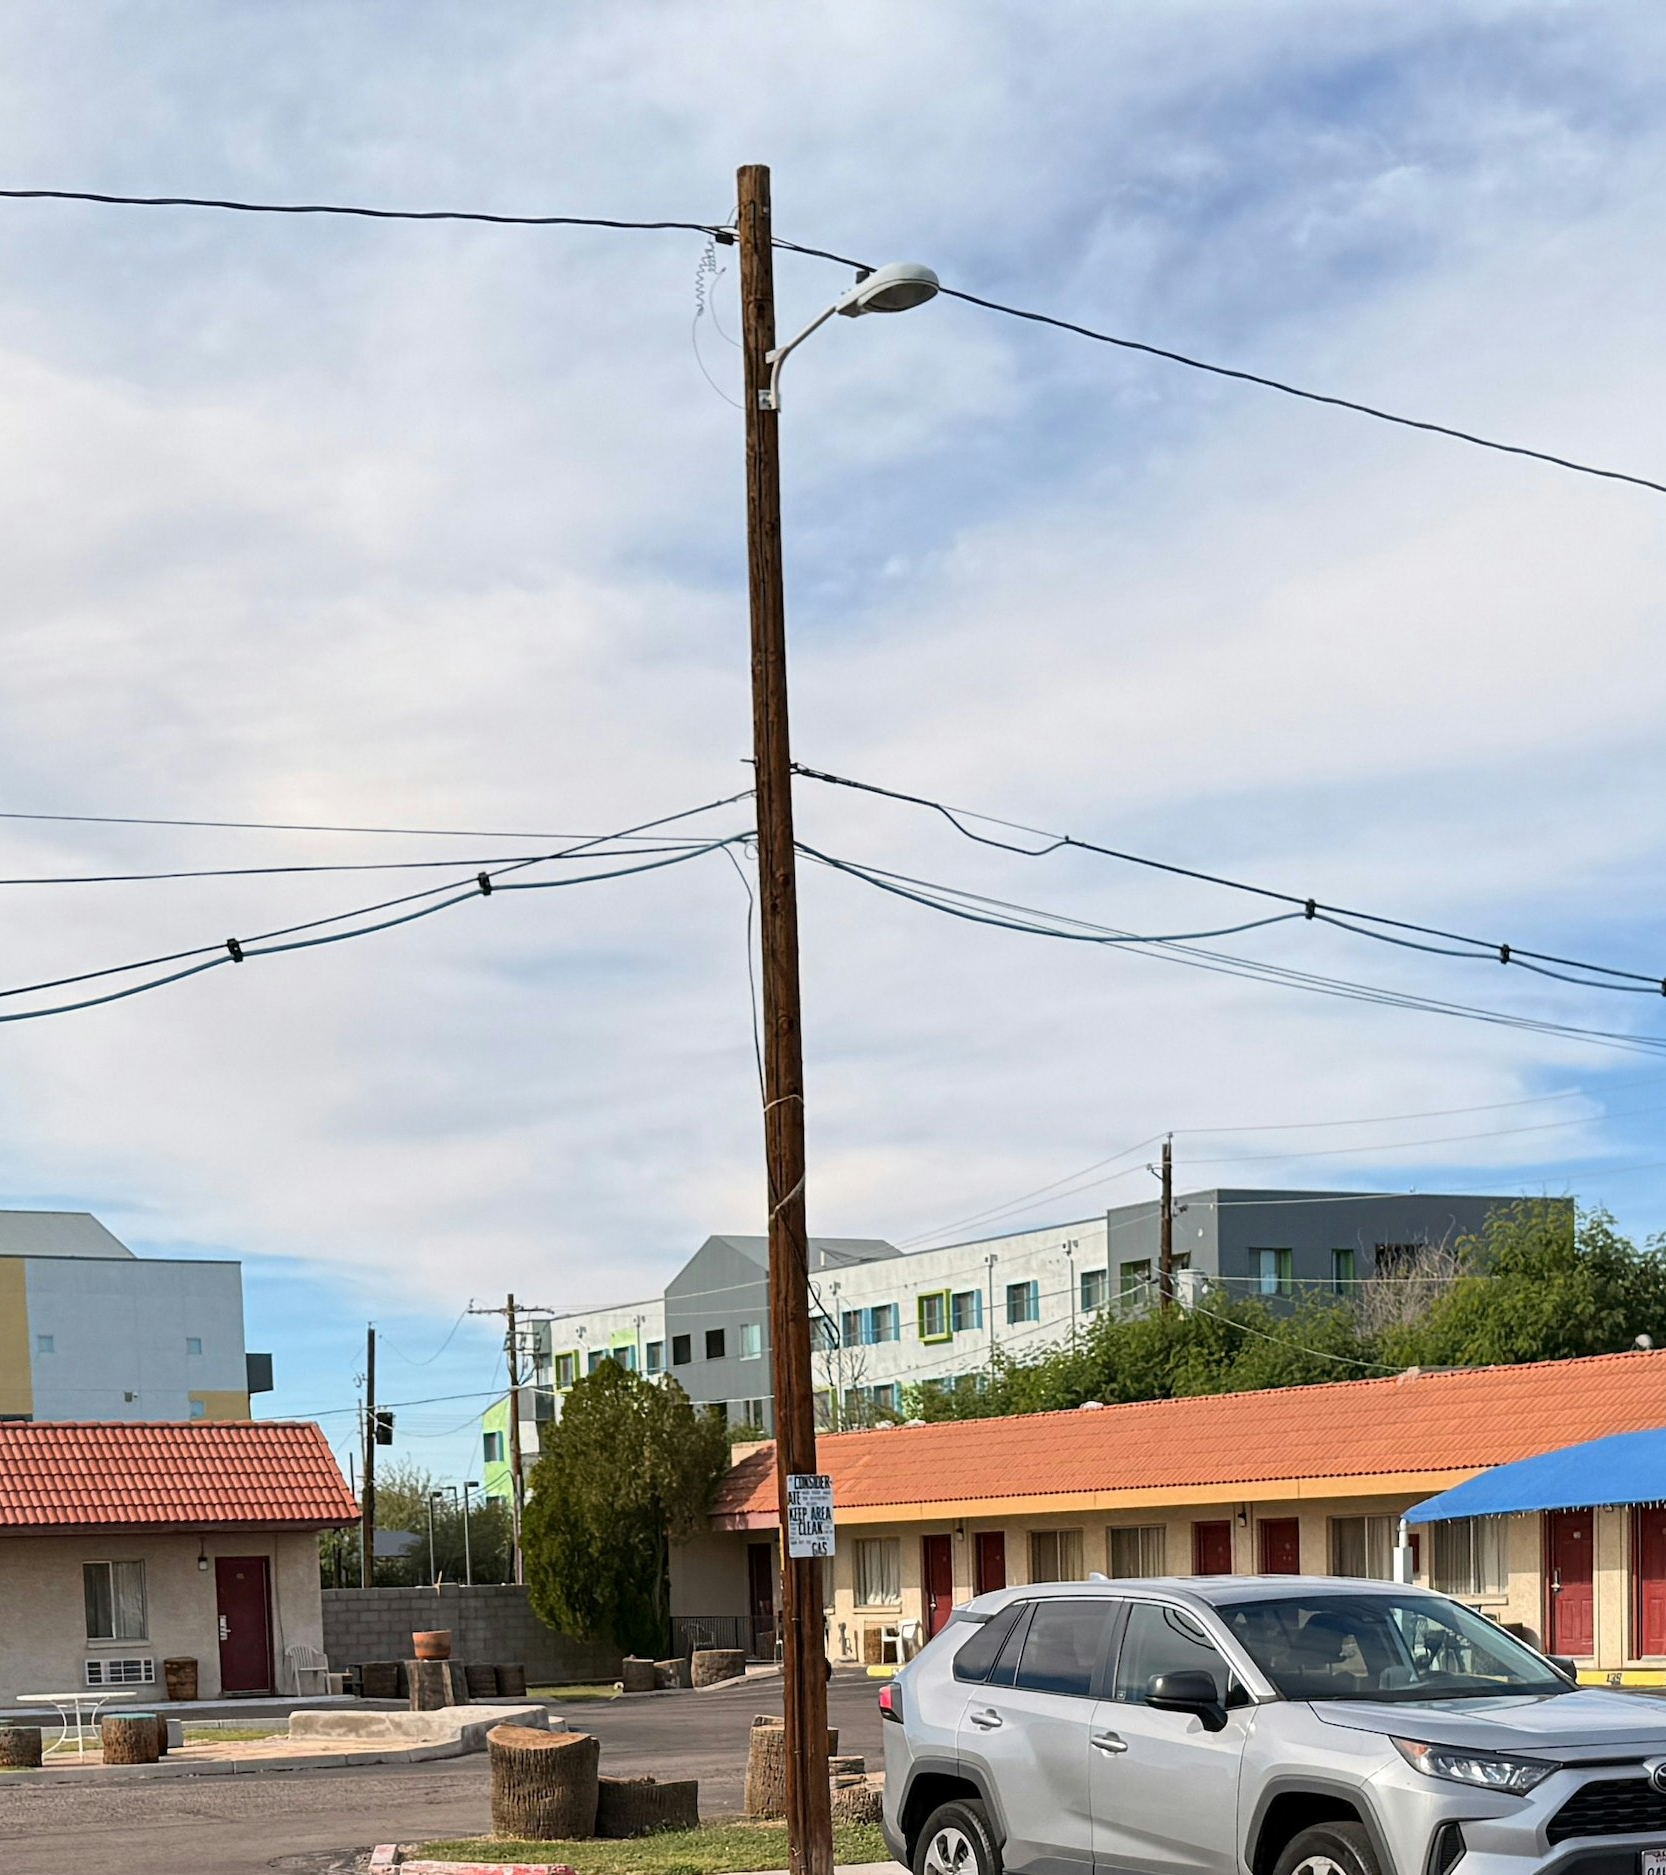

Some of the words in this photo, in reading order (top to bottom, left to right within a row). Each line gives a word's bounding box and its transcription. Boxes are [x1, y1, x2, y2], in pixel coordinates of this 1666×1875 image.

[789, 1507, 807, 1521] KEEP
[810, 1506, 832, 1520] AREA
[798, 1521, 823, 1535] CLEAN
[811, 1541, 828, 1556] GAS
